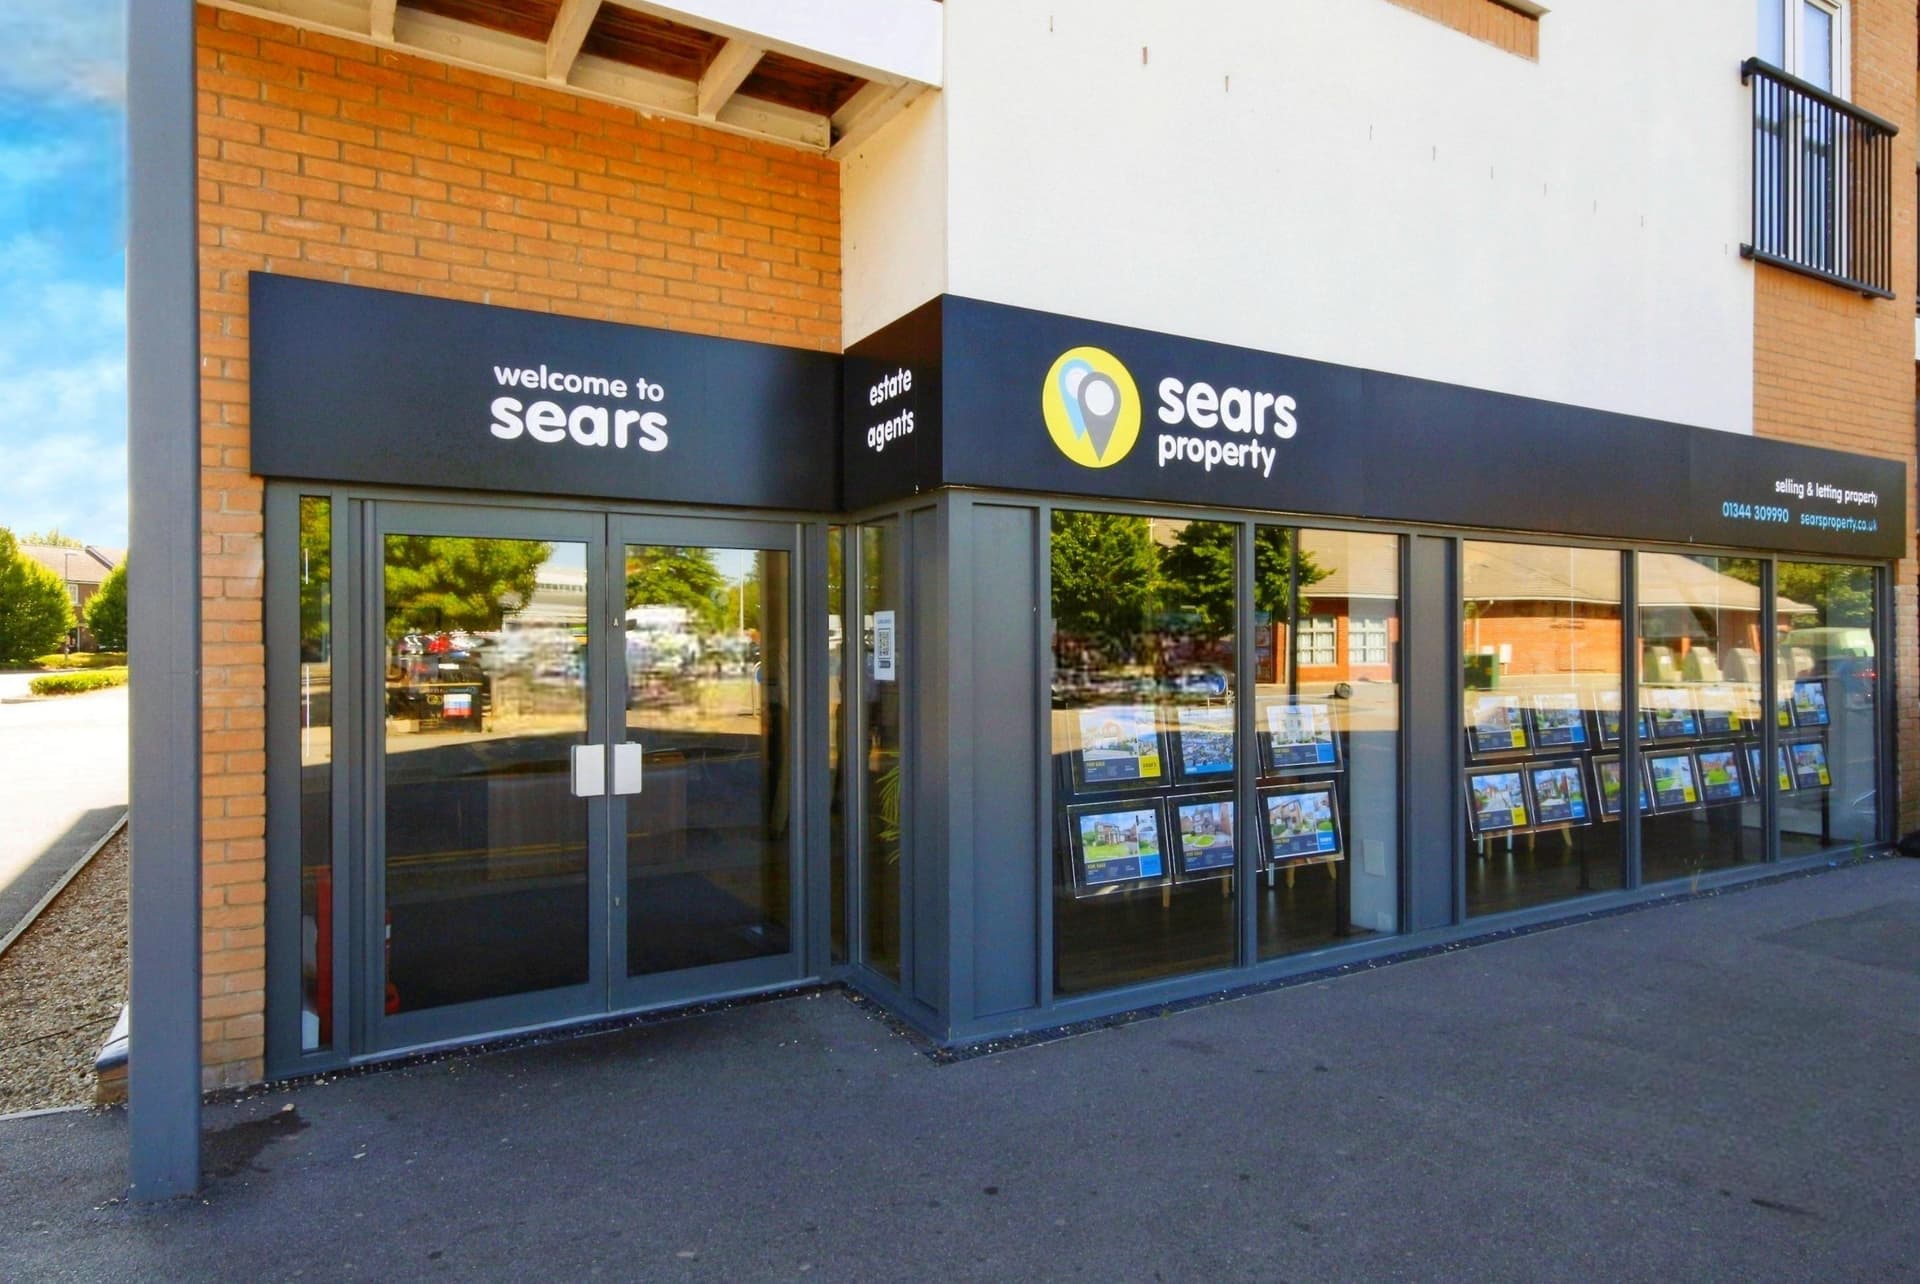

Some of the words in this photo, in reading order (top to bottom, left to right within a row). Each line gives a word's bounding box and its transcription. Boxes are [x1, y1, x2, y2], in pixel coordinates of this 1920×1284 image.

[494, 365, 627, 398] welcome
[636, 377, 665, 402] to
[869, 367, 912, 406] estate
[490, 397, 669, 452] sears
[1158, 377, 1298, 439] sears
[867, 409, 914, 452] agents
[1158, 433, 1276, 479] property
[1775, 478, 1804, 499] selling
[1807, 482, 1813, 496] &
[1816, 483, 1843, 504] letting
[1845, 488, 1878, 508] property
[1722, 501, 1751, 518] 01344
[1754, 505, 1789, 524] 309990
[1800, 512, 1878, 533] searsproperty.co.uk
